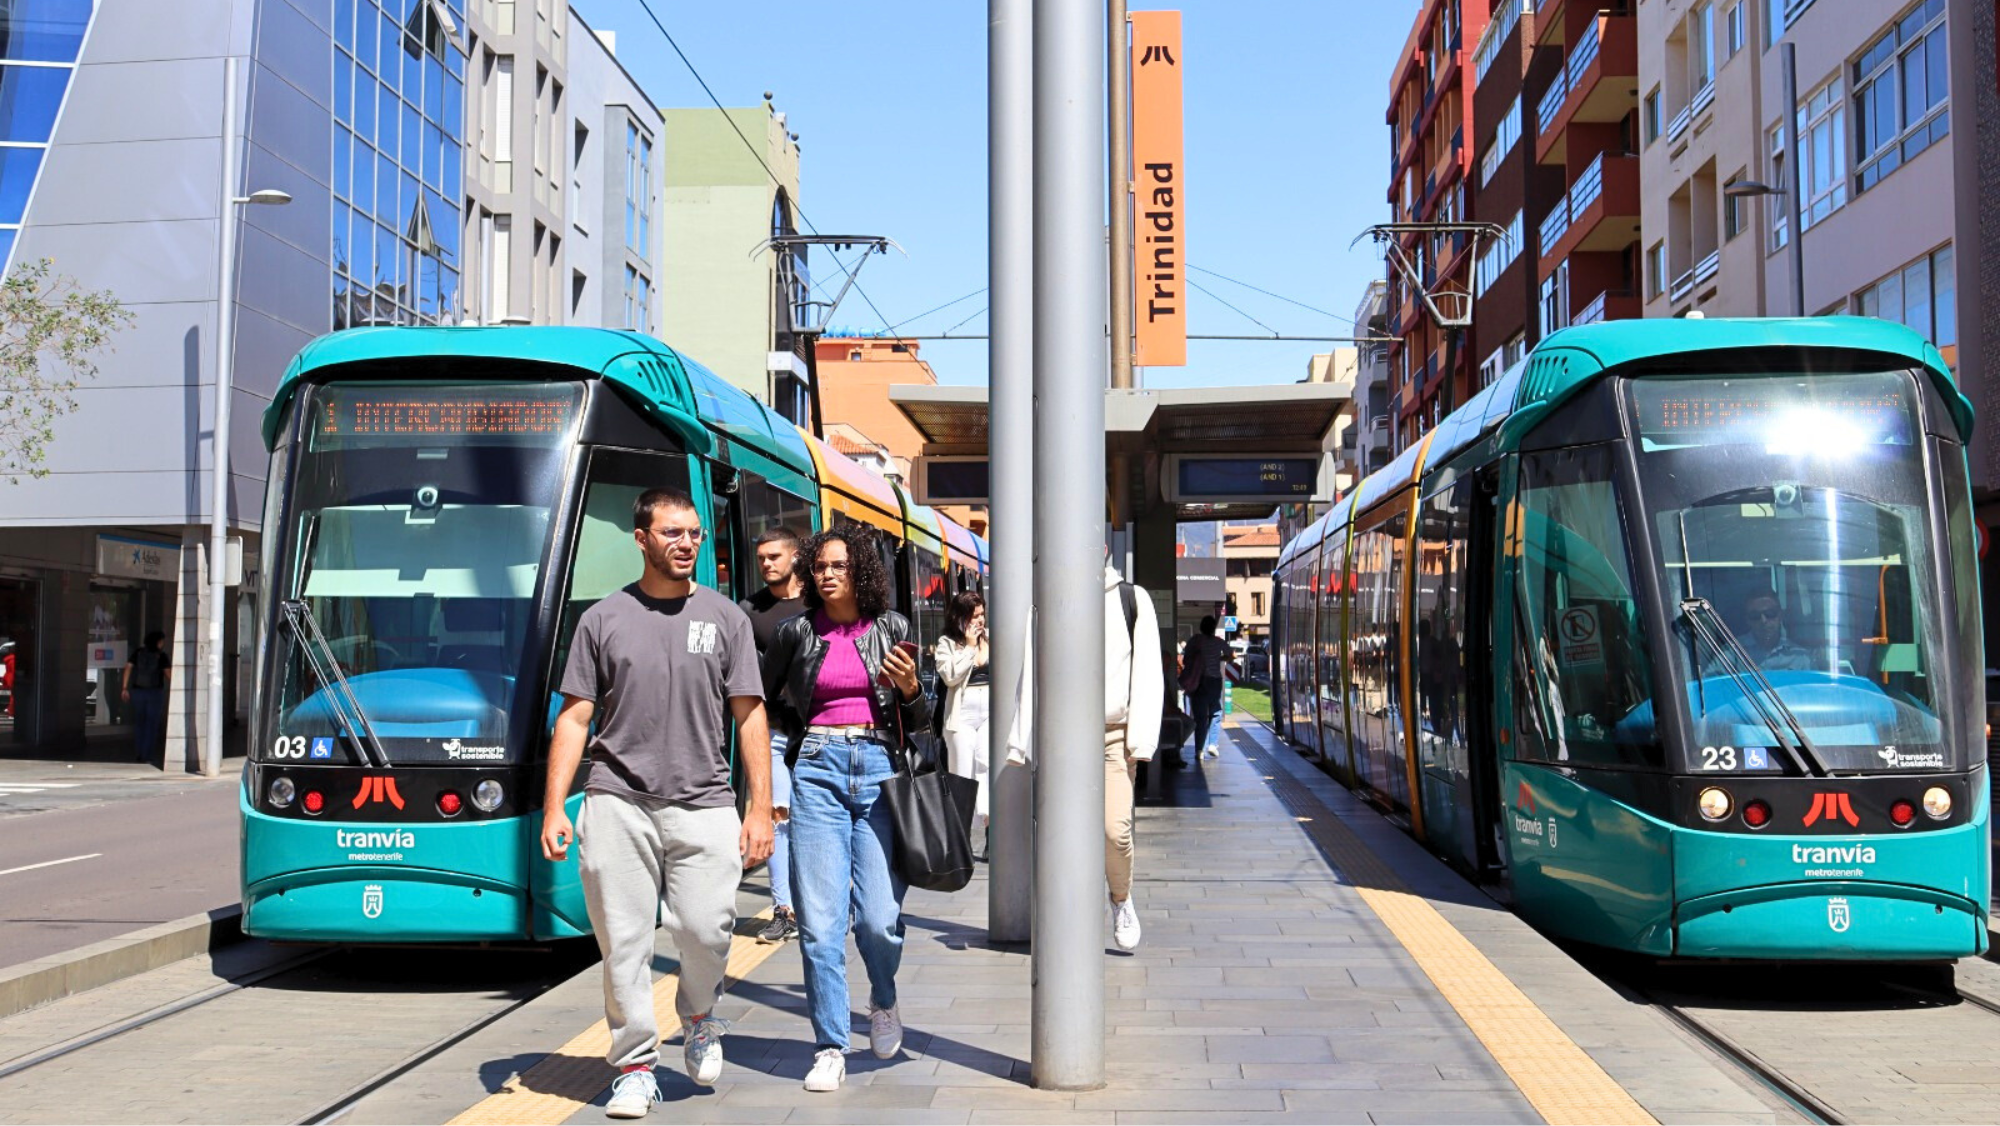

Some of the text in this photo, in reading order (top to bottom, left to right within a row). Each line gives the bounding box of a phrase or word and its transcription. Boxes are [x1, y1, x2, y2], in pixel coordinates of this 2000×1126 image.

[1144, 162, 1175, 323] Trinidad
[324, 402, 566, 433] 1 INTERCAMBIADOR
[274, 735, 306, 759] 03
[461, 746, 505, 755] transporte
[1899, 753, 1943, 761] transporte
[1702, 746, 1737, 771] 23
[336, 828, 415, 848] tranvía
[348, 852, 404, 861] metrotenerife
[1792, 843, 1876, 863] tranvía
[1804, 867, 1864, 877] metrotenerife
